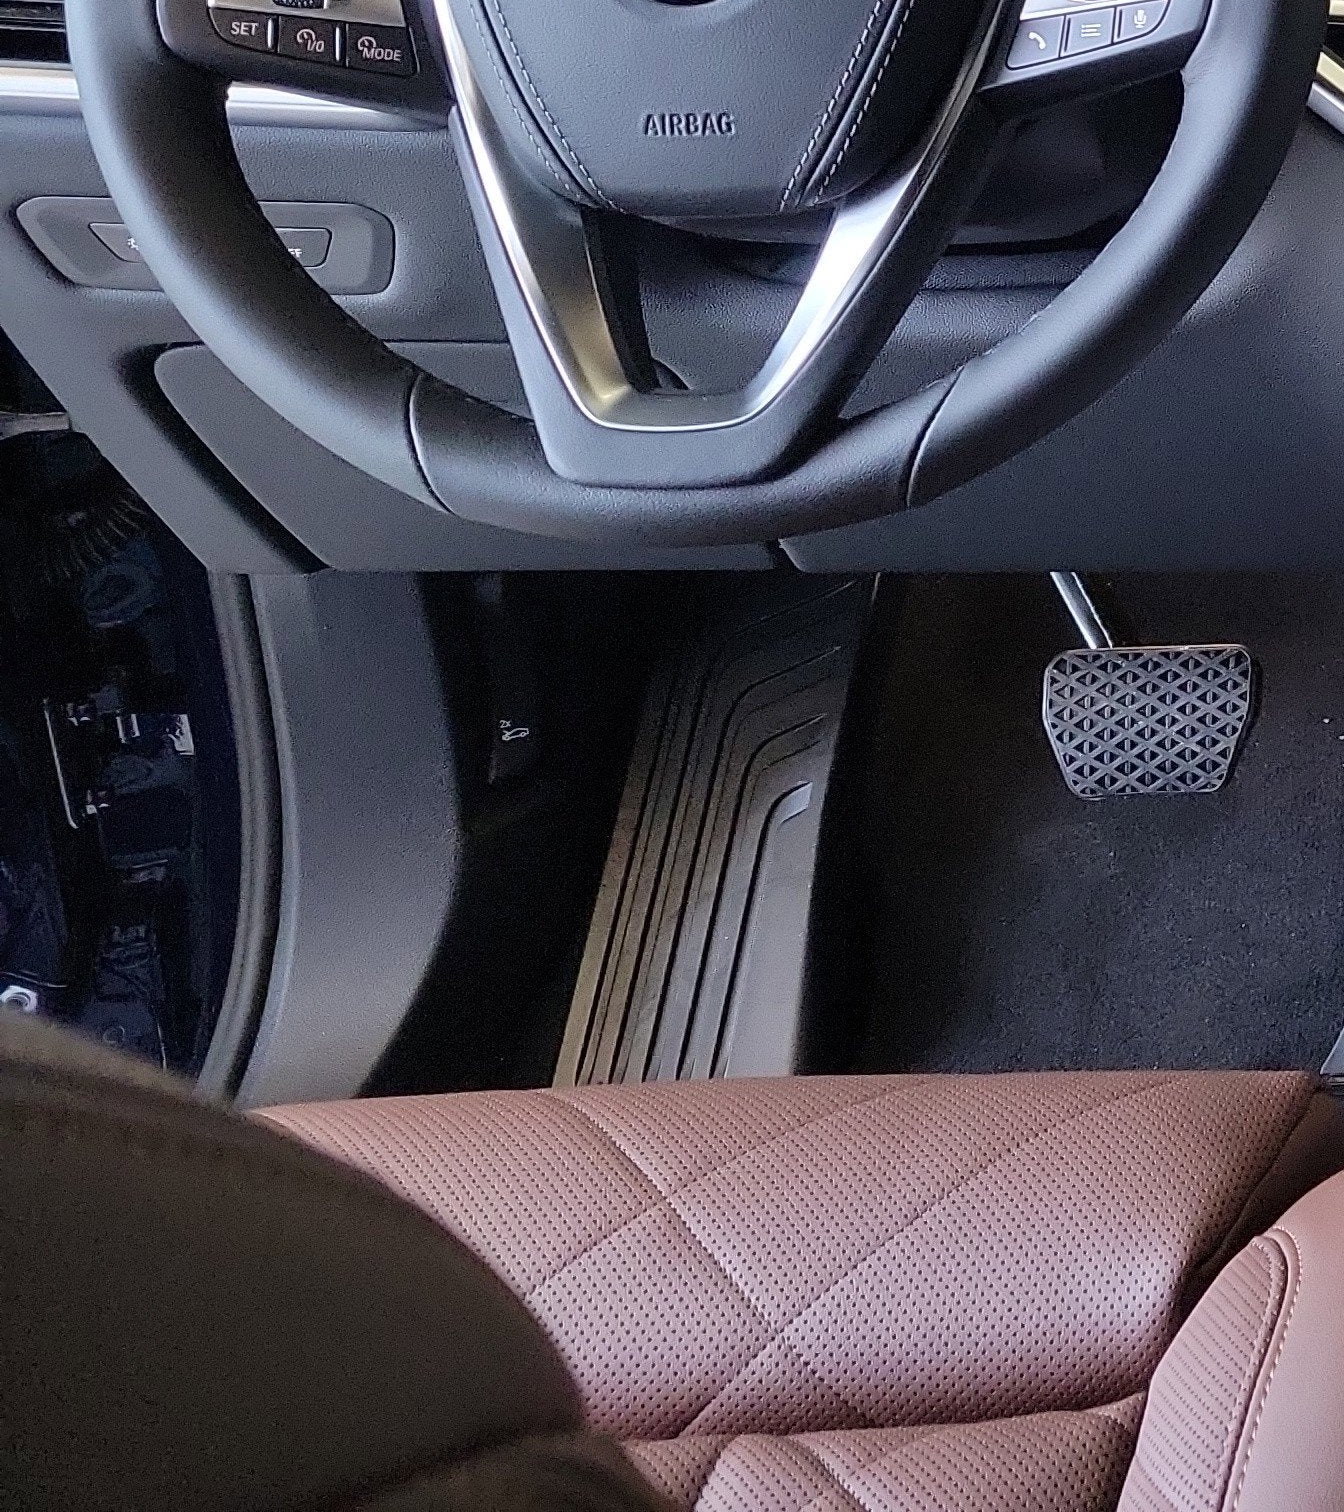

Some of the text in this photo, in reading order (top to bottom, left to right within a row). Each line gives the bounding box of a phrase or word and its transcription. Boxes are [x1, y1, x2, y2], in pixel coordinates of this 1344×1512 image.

[231, 21, 259, 37] SET
[362, 47, 401, 62] MODE
[644, 111, 736, 137] AIRBAG
